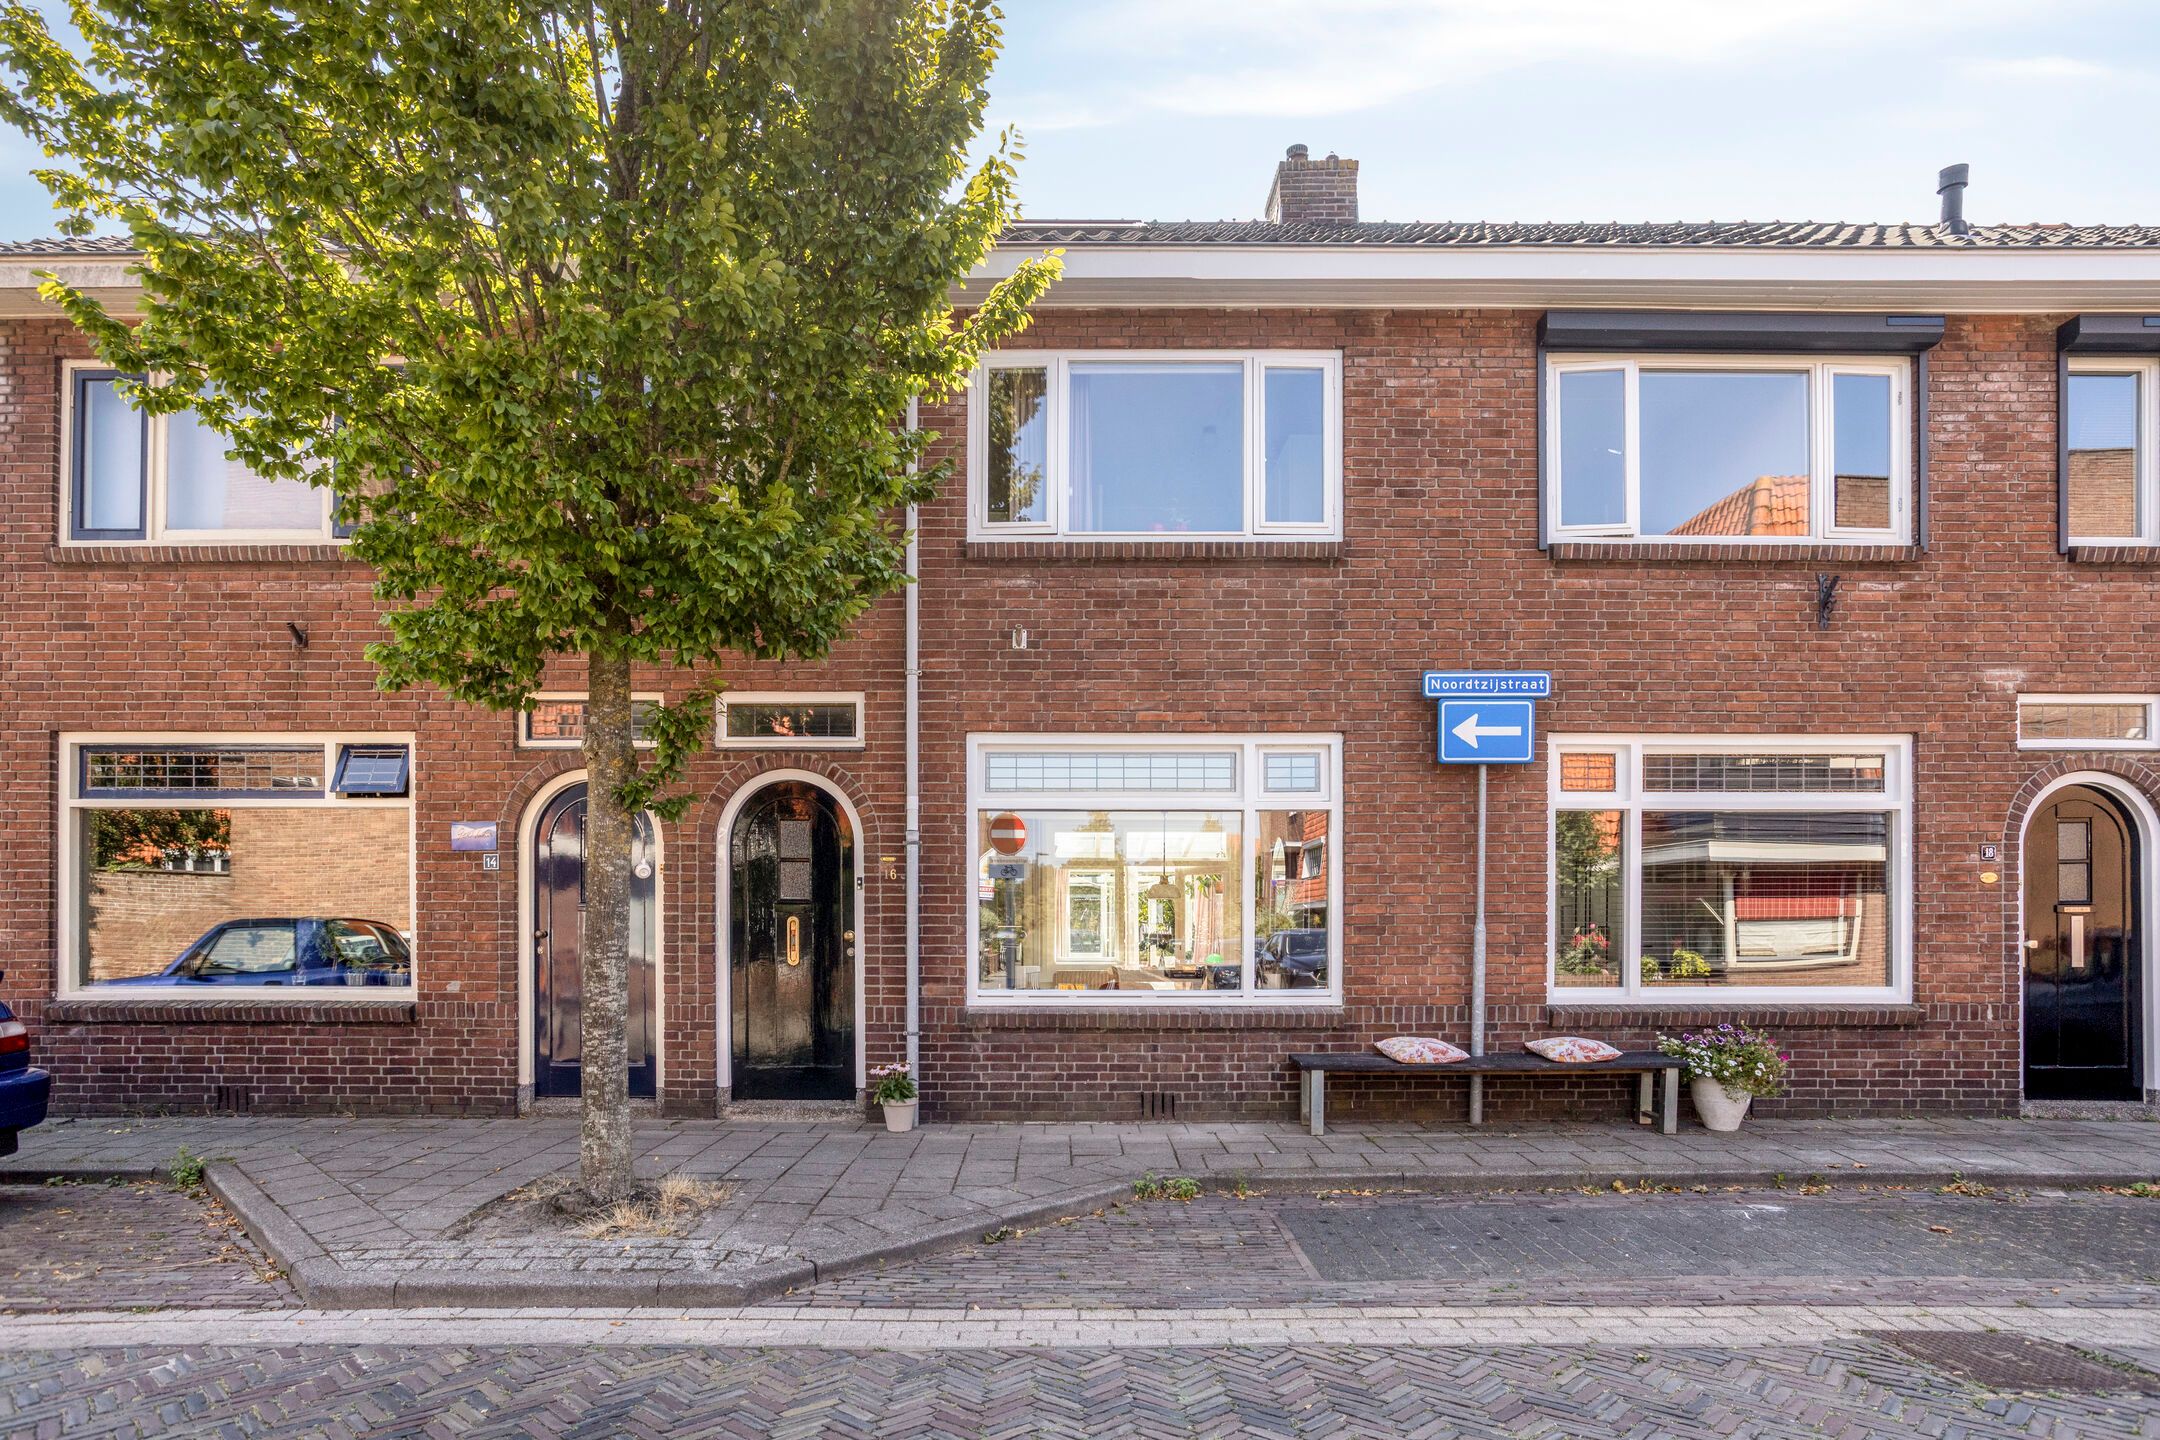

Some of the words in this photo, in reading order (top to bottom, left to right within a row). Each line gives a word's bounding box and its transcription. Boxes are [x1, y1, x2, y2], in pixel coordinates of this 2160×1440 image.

[1431, 678, 1545, 692] Noordtzijstraat
[1985, 847, 1994, 857] 18
[486, 857, 497, 868] 14
[884, 868, 897, 880] 16
